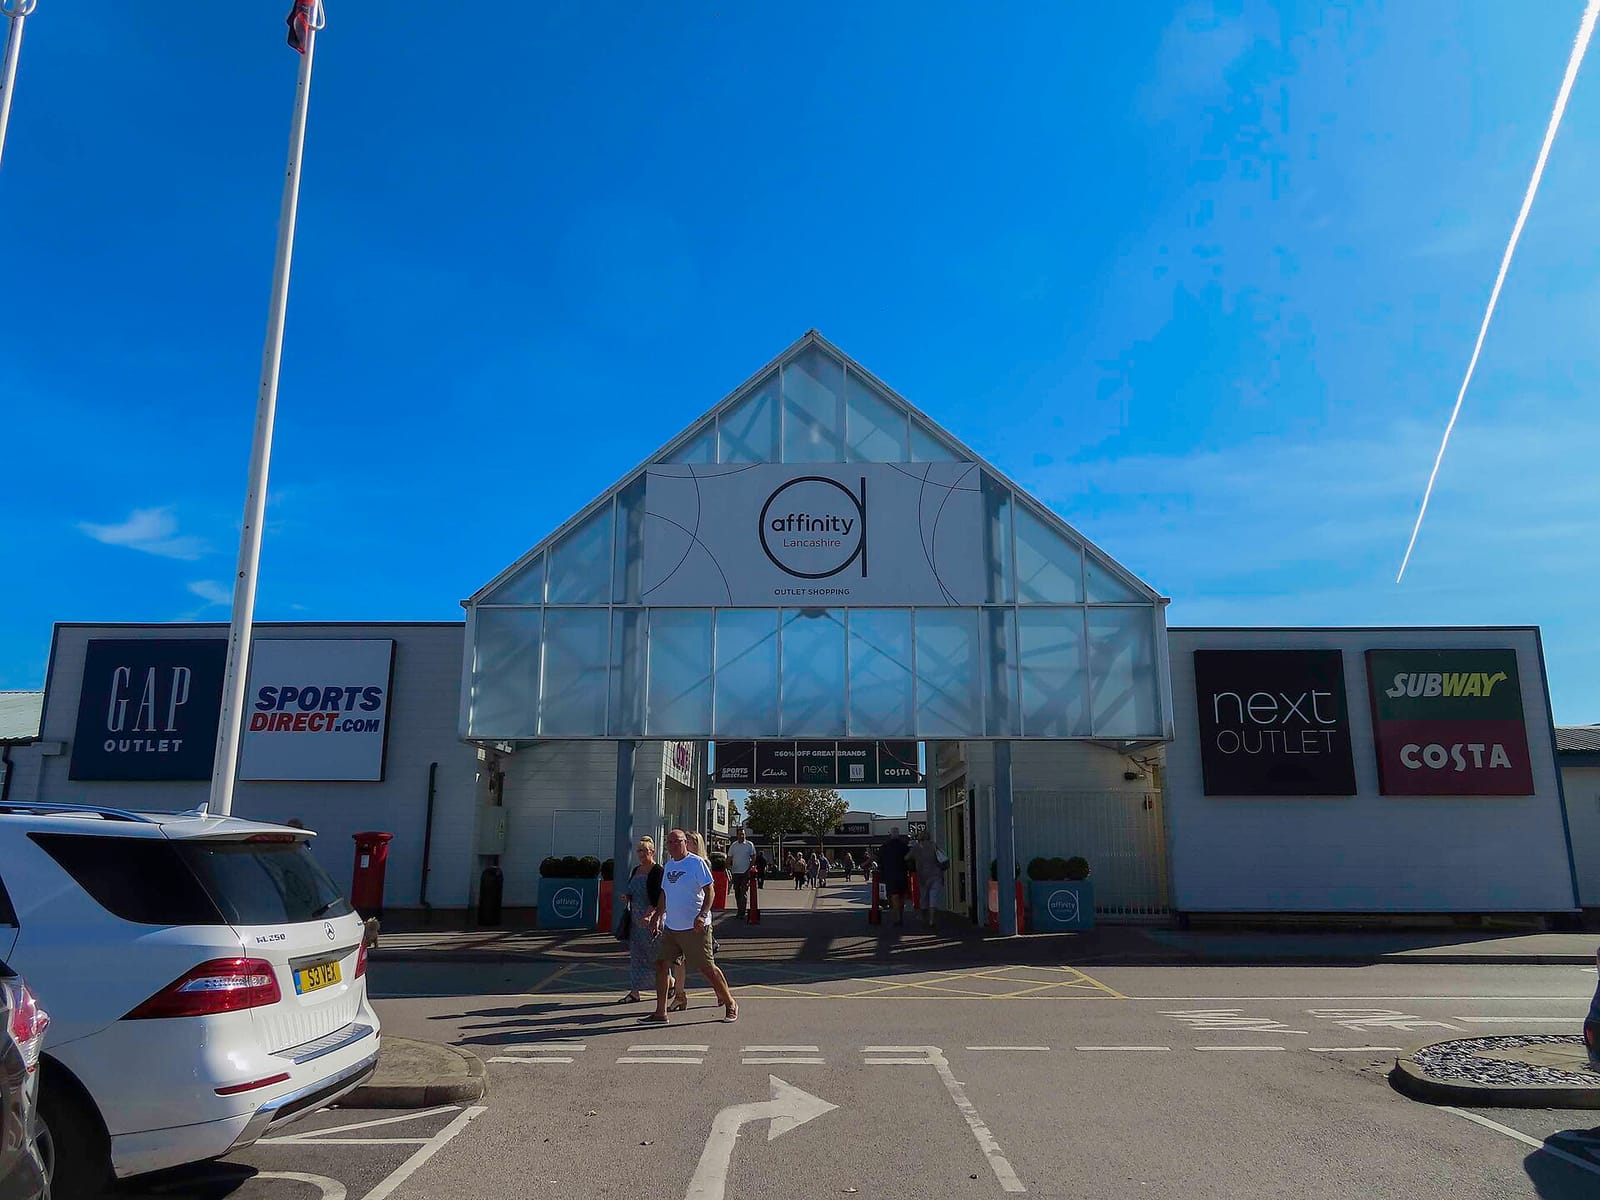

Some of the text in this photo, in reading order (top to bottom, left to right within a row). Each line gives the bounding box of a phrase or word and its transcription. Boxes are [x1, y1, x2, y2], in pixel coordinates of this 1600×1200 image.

[771, 513, 854, 535] affinity
[783, 539, 841, 548] Lancashire
[774, 588, 850, 596] OUTLET SHOPPING
[1385, 671, 1508, 699] SUBWAY
[107, 666, 191, 732] GAP
[255, 686, 383, 711] SPORTS
[1213, 689, 1337, 725] next
[103, 739, 183, 753] OUTLET
[1216, 729, 1336, 754] OUTLET
[803, 765, 829, 774] next
[1399, 743, 1512, 772] COSTA
[884, 768, 911, 776] COSTA
[307, 962, 337, 987] S3 VEX
